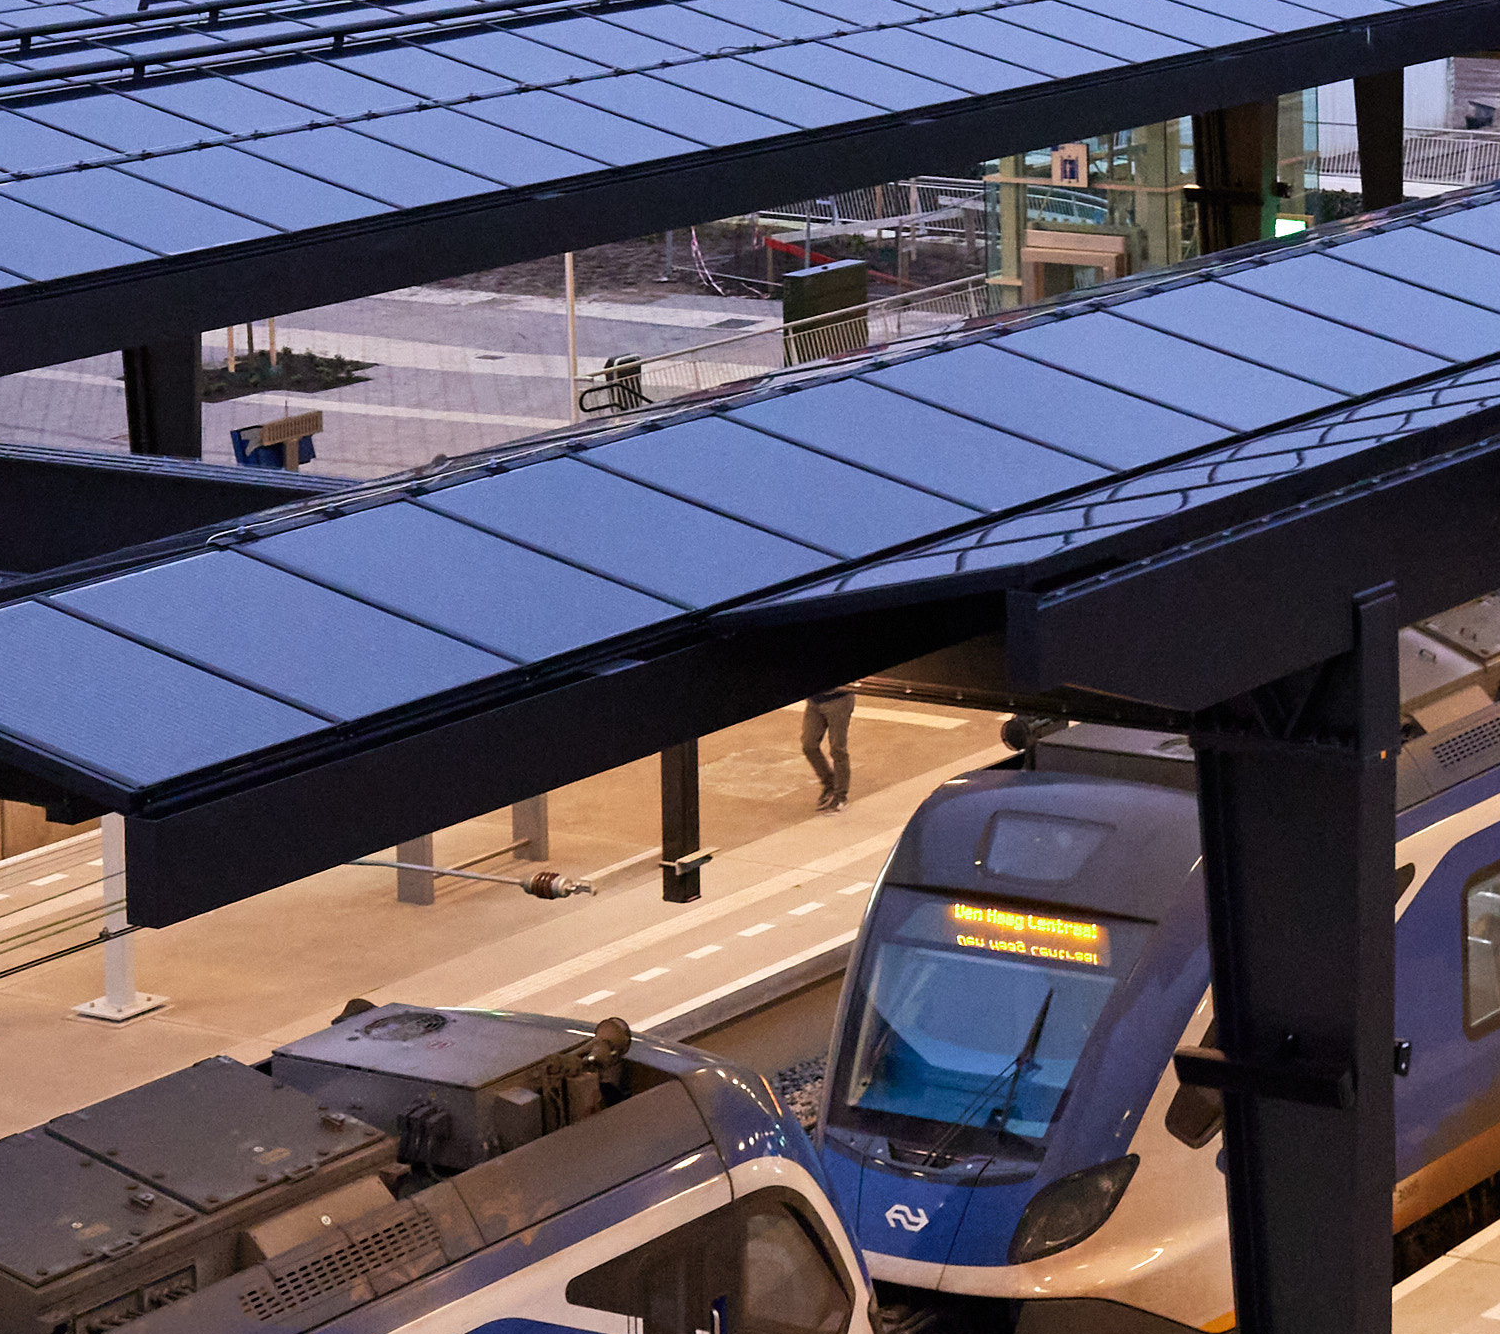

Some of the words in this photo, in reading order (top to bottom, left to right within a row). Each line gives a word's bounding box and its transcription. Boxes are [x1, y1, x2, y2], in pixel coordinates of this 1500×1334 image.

[954, 903, 983, 922] Den
[987, 908, 1025, 931] Haag
[1027, 914, 1097, 940] Centraal
